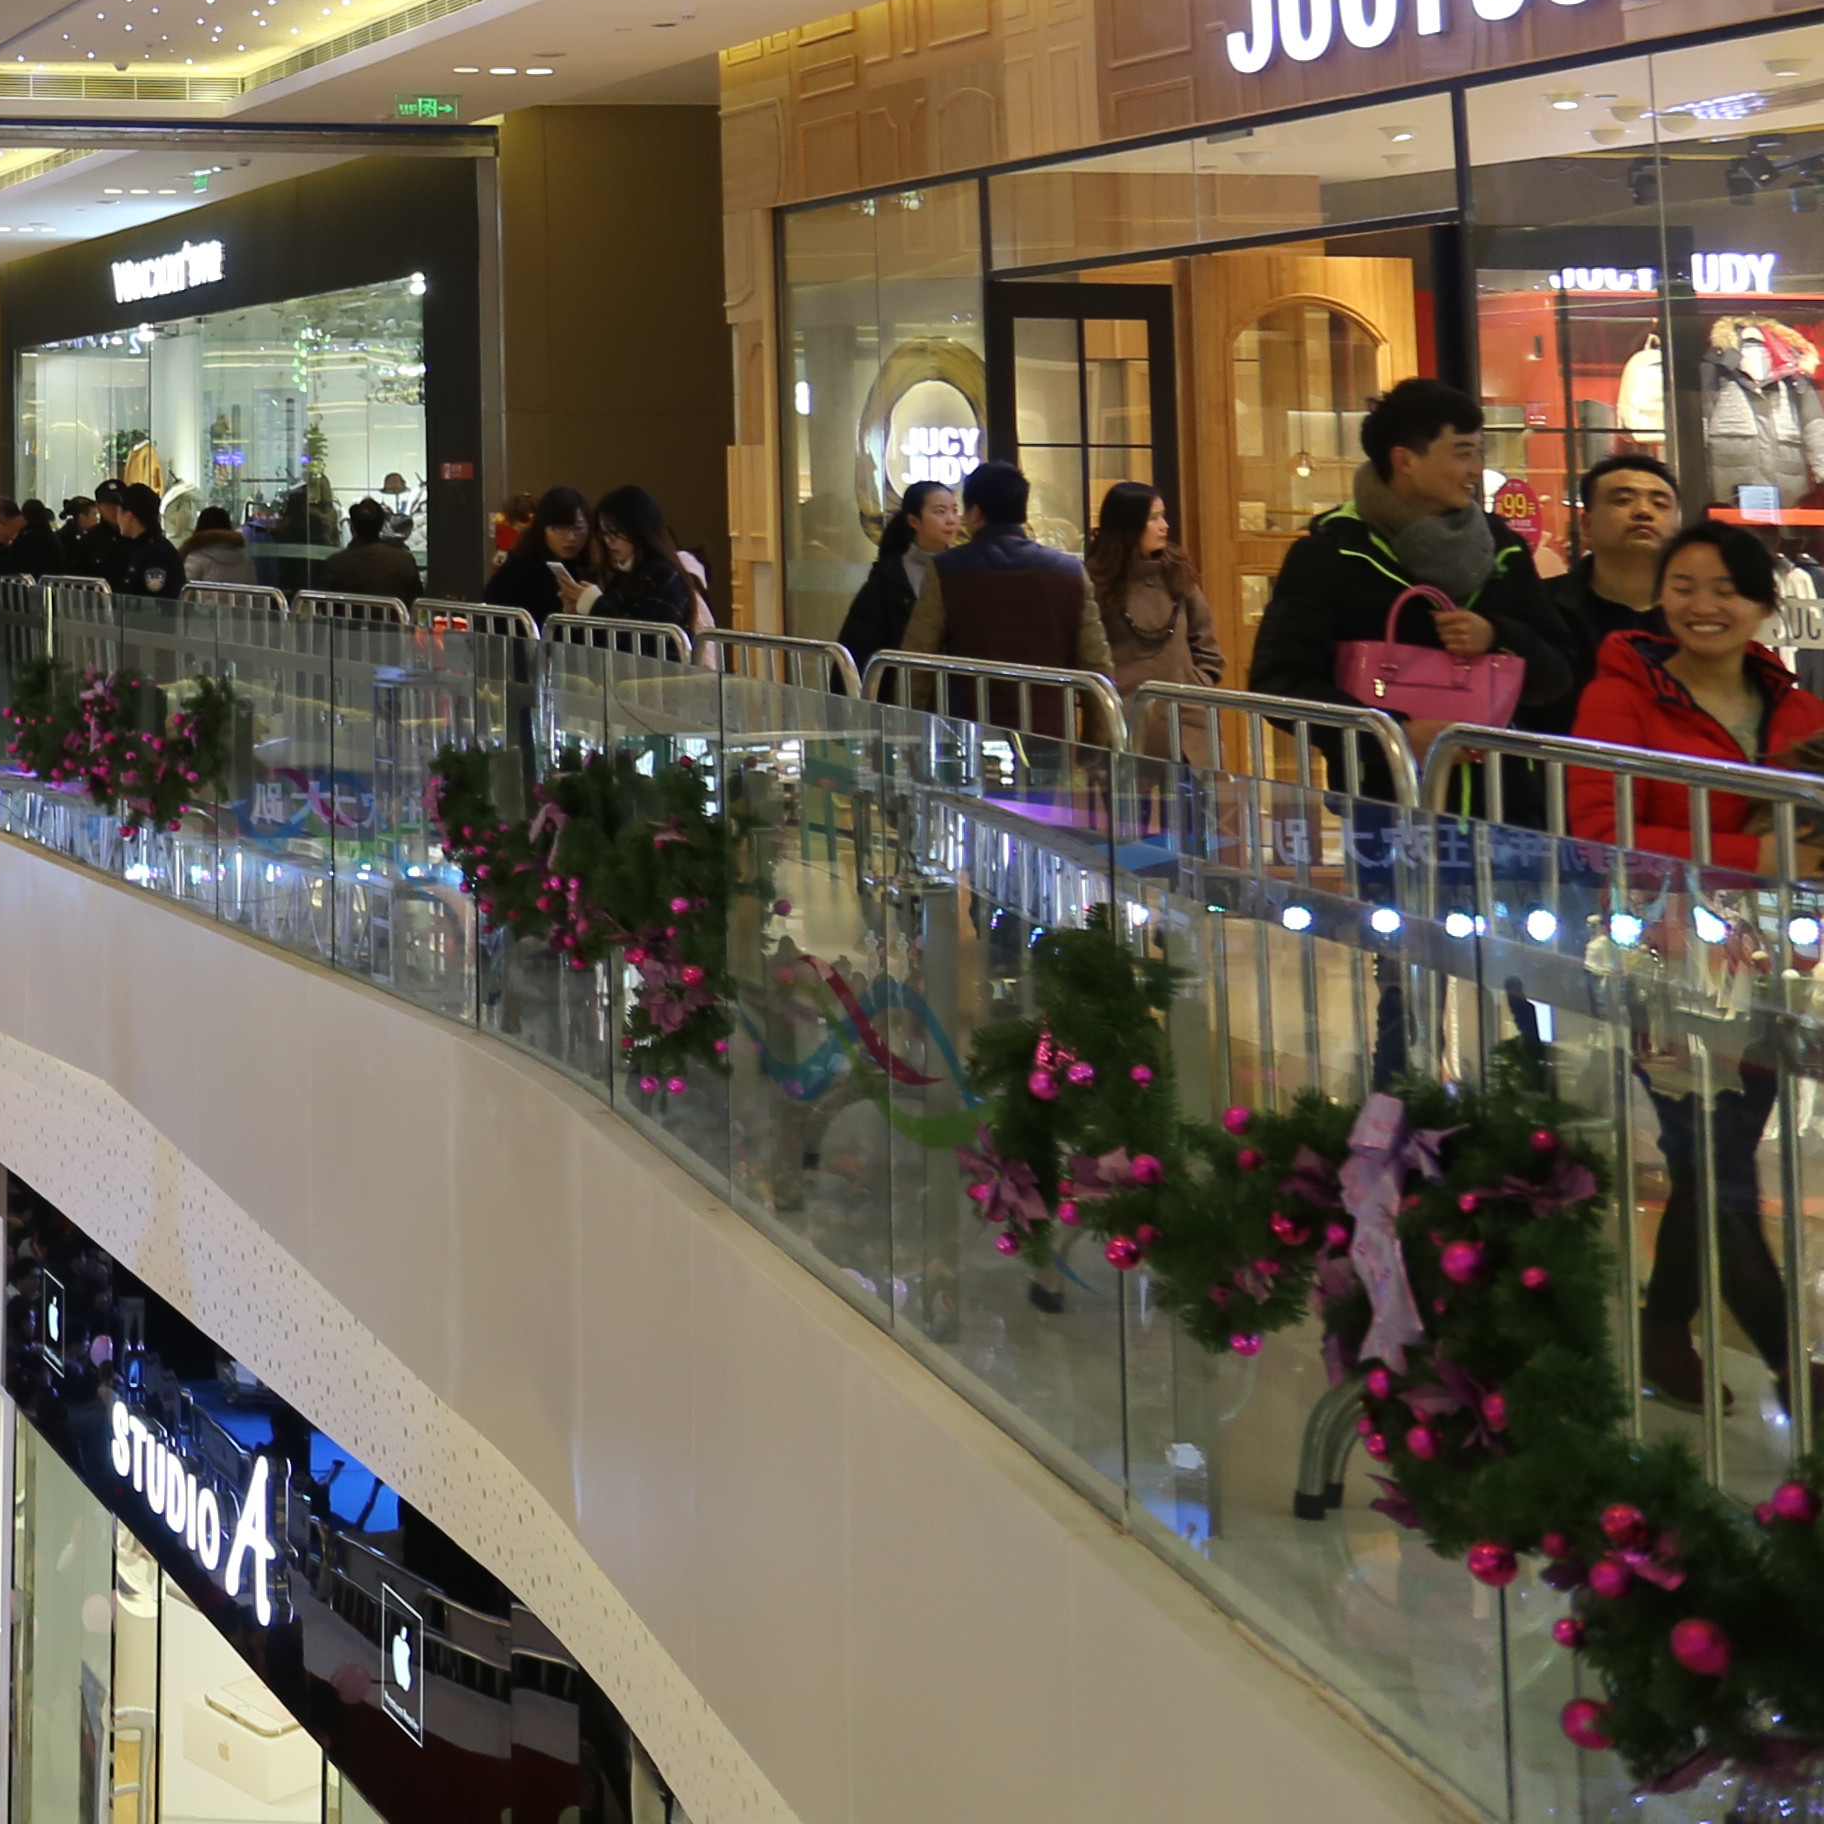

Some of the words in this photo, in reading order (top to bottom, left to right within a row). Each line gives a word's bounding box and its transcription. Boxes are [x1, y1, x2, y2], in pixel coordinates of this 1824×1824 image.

[1690, 257, 1775, 293] UDY
[900, 426, 981, 456] JUCY
[1772, 606, 1824, 641] JUC
[111, 1400, 221, 1572] STUDIO
[225, 1455, 277, 1627] A
